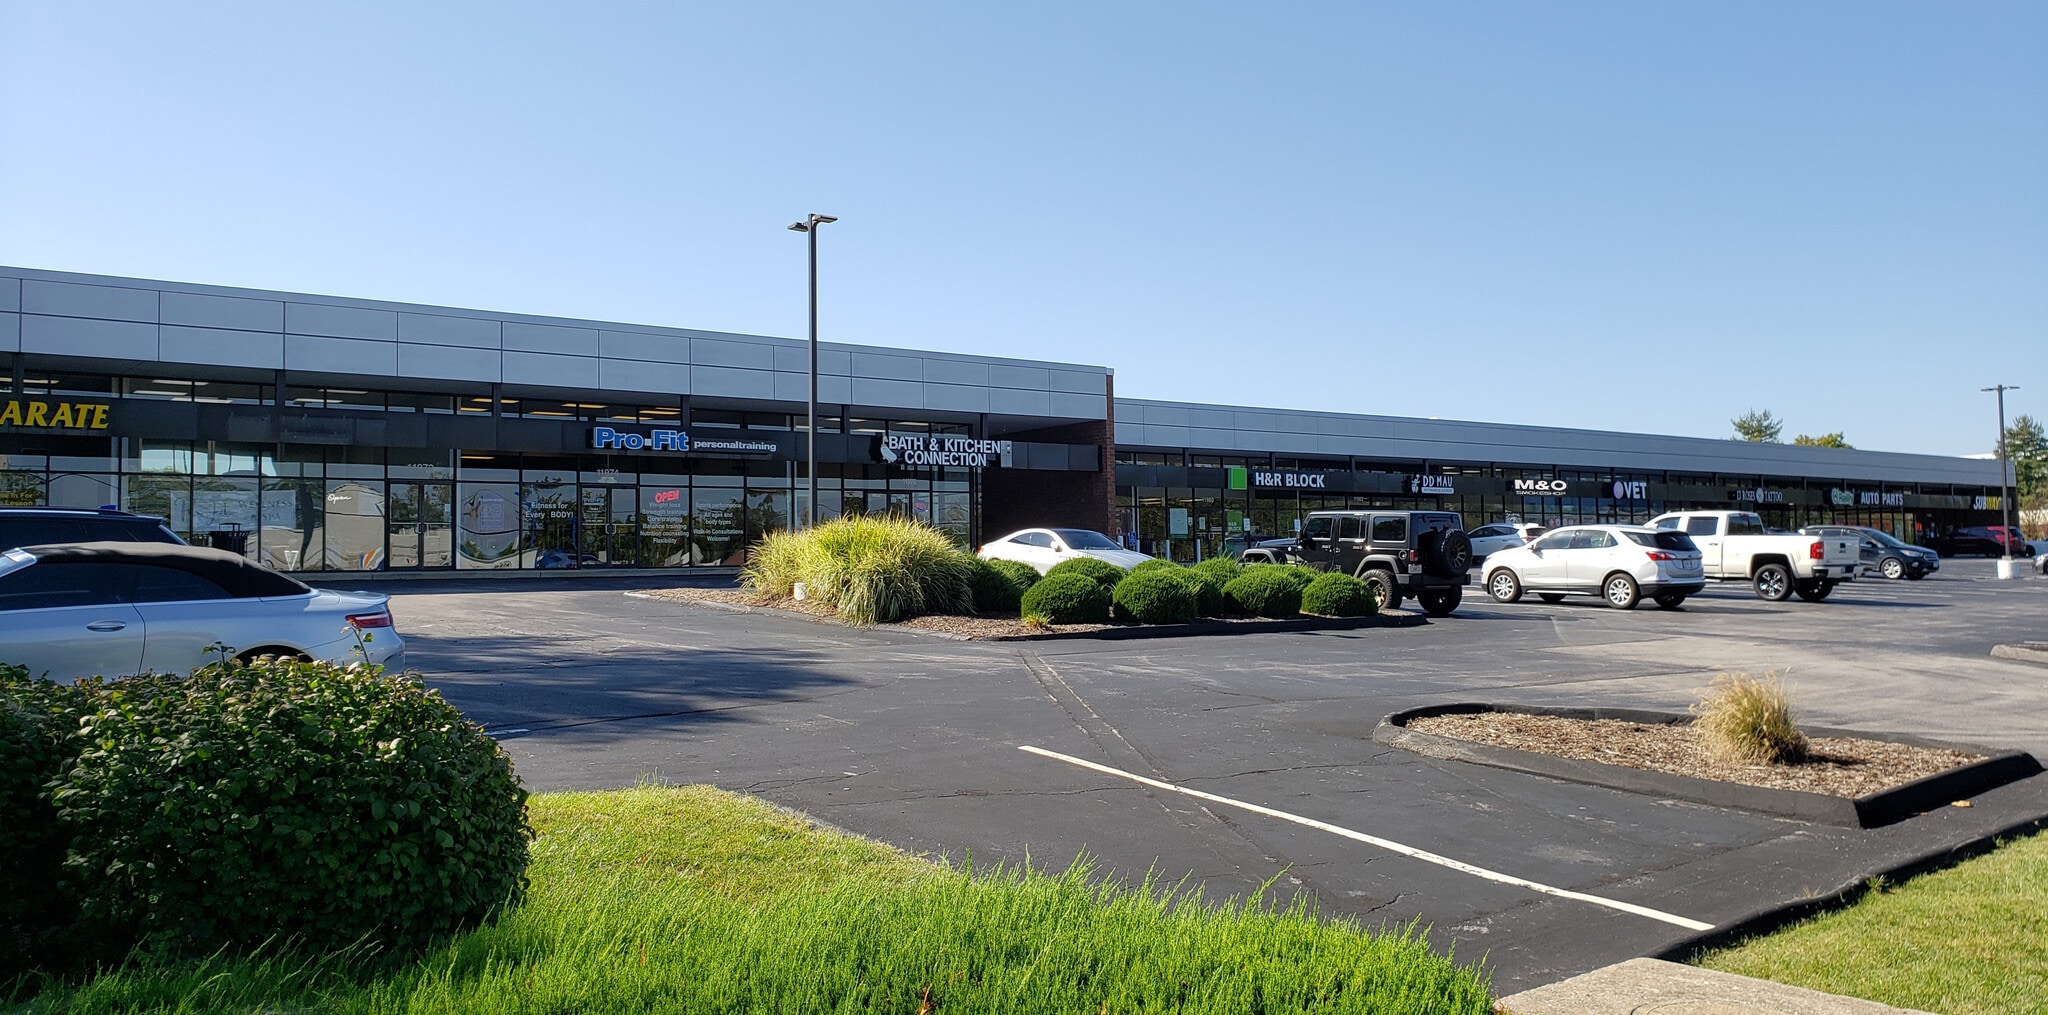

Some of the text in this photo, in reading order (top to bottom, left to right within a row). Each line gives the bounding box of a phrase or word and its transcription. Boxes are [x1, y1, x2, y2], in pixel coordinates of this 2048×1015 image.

[0, 400, 110, 429] ARATE
[593, 426, 777, 451] Pro-Fit personaltraining
[888, 435, 1000, 454] BATH & KITCHEN
[904, 450, 987, 467] CONNECTION
[1255, 472, 1325, 488] H&R BLOCK
[1422, 475, 1435, 487] DD
[1514, 479, 1567, 491] M&O
[655, 490, 679, 503] OPEN
[1623, 481, 1647, 499] VET
[327, 493, 353, 505] Open
[1860, 491, 1904, 506] AUTO PARTS
[1973, 495, 2002, 510] SUBWAY
[525, 511, 545, 519] Every
